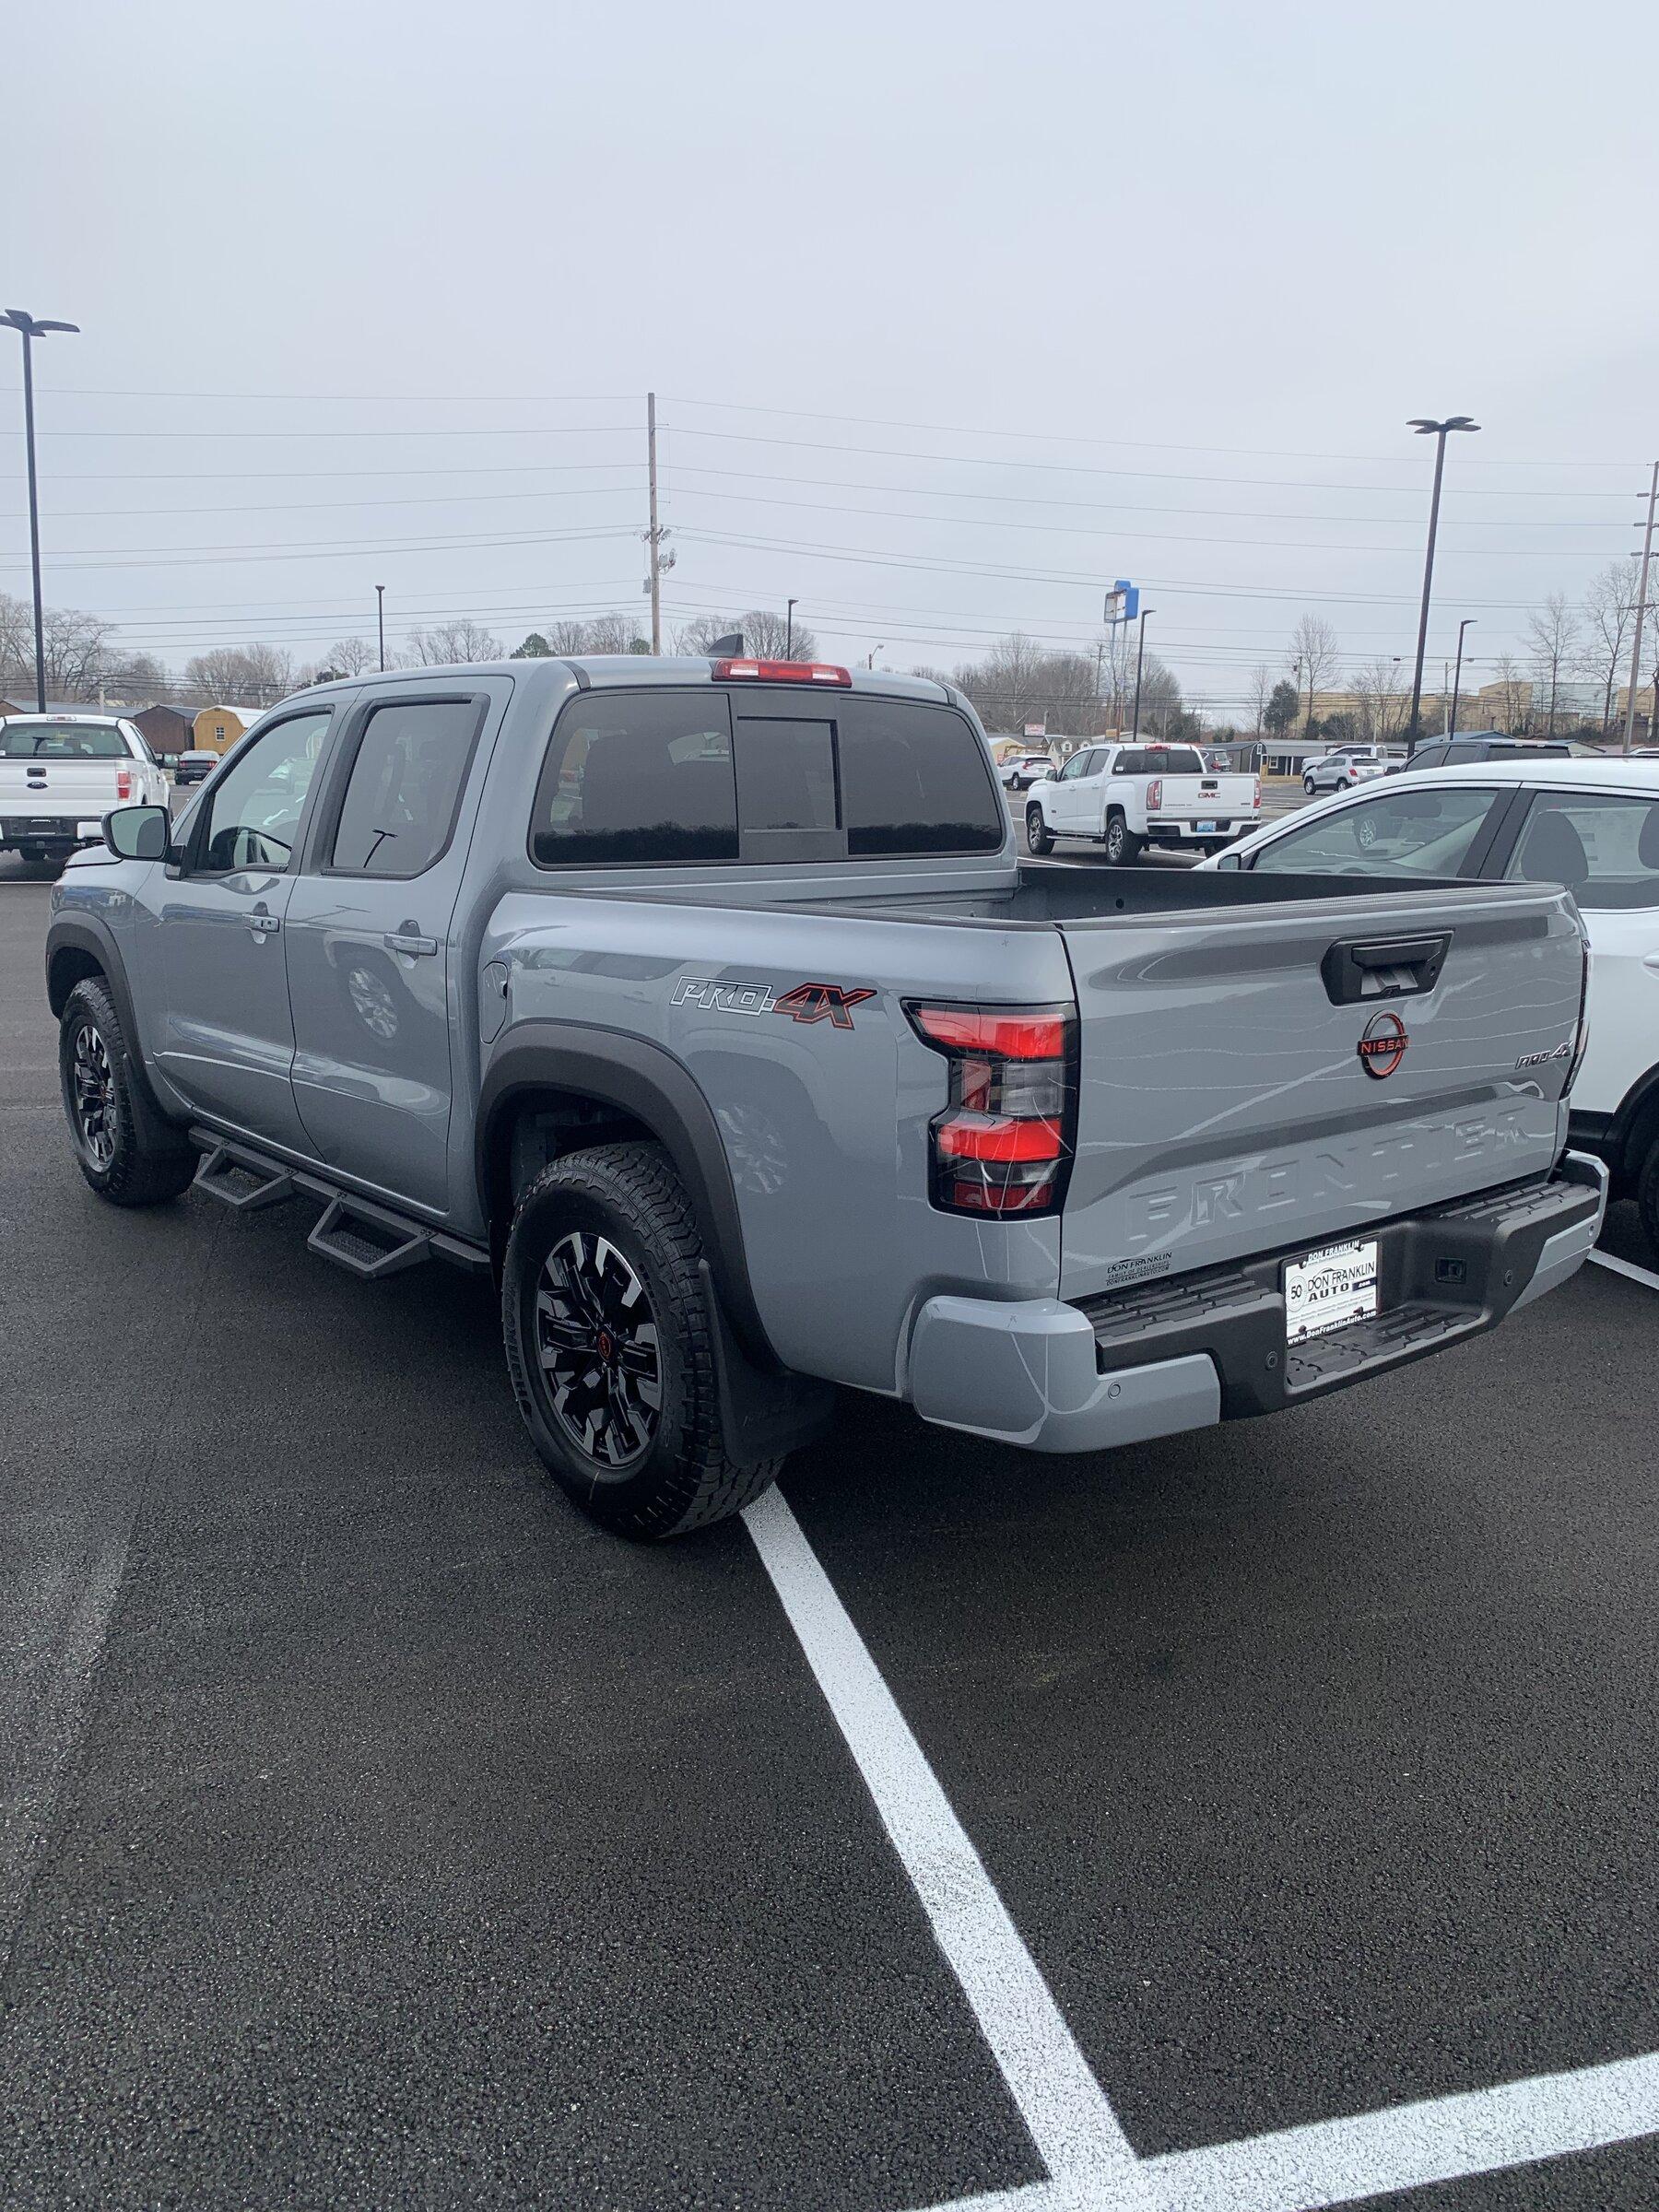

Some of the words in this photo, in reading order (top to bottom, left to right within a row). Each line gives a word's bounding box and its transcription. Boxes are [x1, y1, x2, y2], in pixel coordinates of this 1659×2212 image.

[1361, 1037, 1408, 1053] NISSAN
[1308, 1253, 1323, 1261] DON
[1324, 1240, 1359, 1257] FRANKLIN
[1107, 1264, 1128, 1274] DON
[1130, 1252, 1172, 1268] FRANKLIN
[1308, 1274, 1328, 1291] DON
[1332, 1261, 1374, 1284] FRANKLIN
[1290, 1284, 1302, 1300] 50
[1309, 1282, 1349, 1302] AUTO
[1288, 1310, 1376, 1345] www.DonFranklinAuto.com
